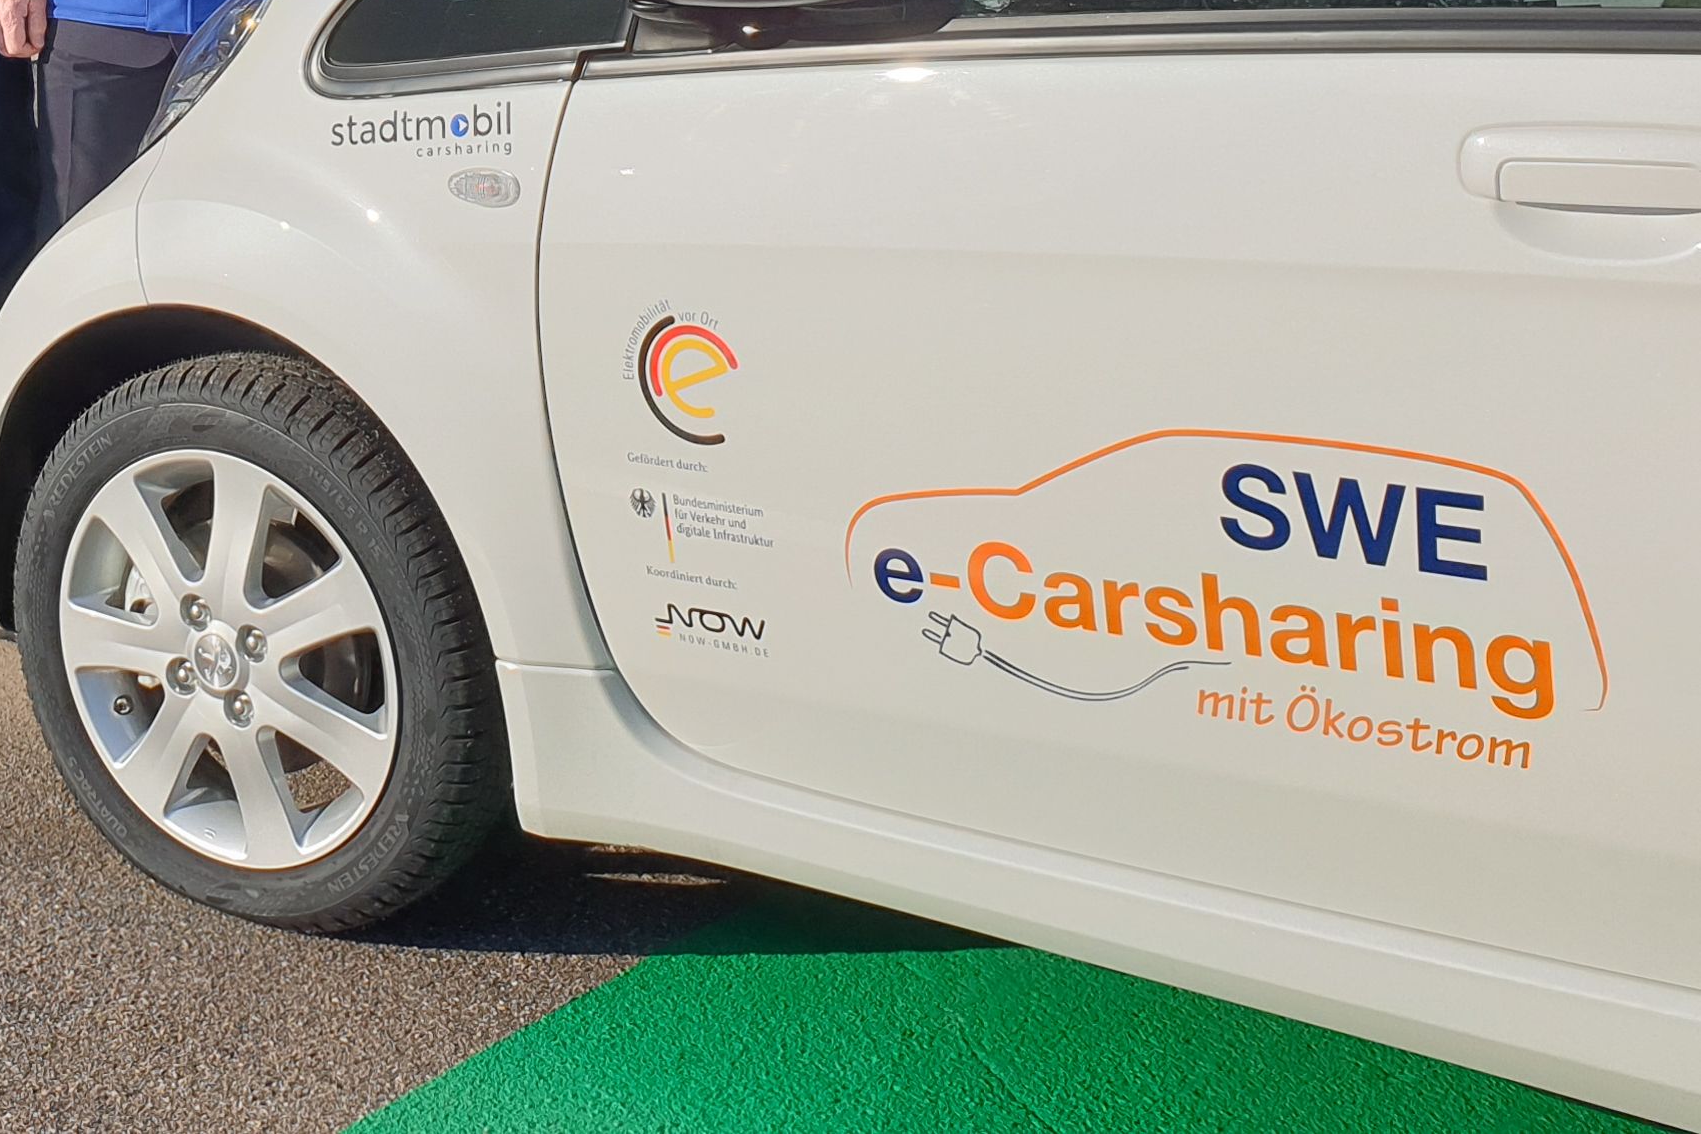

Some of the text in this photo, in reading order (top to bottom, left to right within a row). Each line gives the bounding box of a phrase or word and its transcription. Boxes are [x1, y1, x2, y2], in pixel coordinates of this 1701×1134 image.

[330, 101, 512, 147] stadtmobil
[416, 140, 513, 158] carsharing
[622, 299, 719, 381] Elektromobilität vor Ort
[627, 451, 709, 473] Gefördert durch:
[672, 493, 765, 518] Bundesministerium
[674, 508, 747, 530] für Verkehr und
[1220, 462, 1489, 582] SWE
[676, 522, 774, 548] digitale Infrastruktur
[646, 565, 738, 590] Koordiniert durch:
[654, 602, 766, 641] NOW
[873, 539, 1555, 720] e-Carsharing
[678, 632, 770, 658] NOW-GMBH.DE
[1197, 685, 1532, 770] mit Ökostrom
